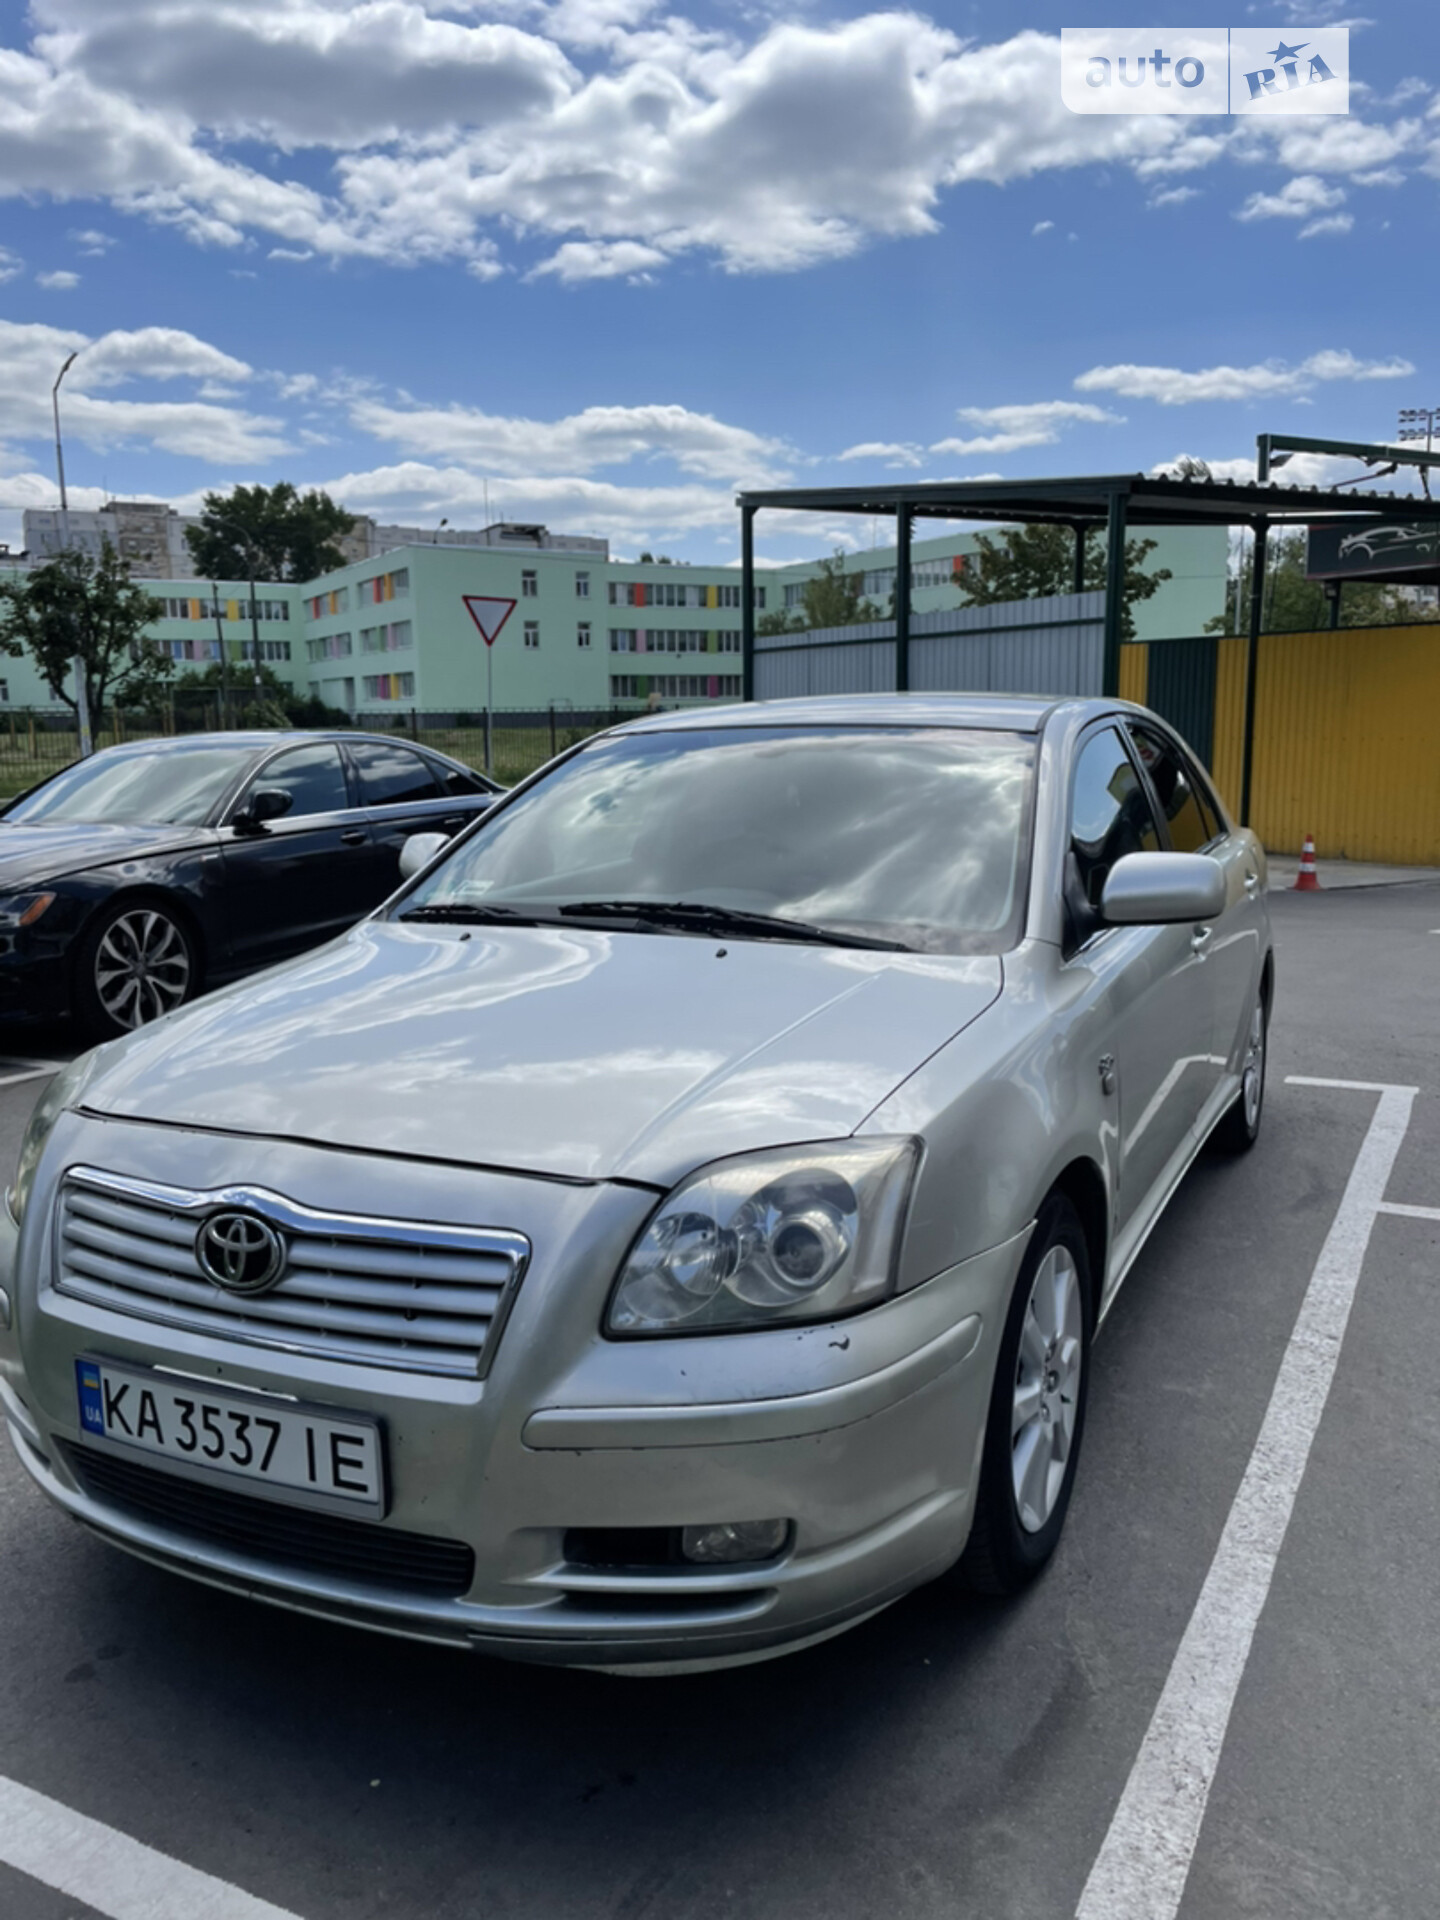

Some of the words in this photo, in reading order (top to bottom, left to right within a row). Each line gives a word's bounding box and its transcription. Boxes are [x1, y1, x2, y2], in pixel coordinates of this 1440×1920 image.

[84, 1405, 103, 1424] UA
[103, 1377, 165, 1445] KA
[173, 1397, 282, 1472] 3537
[305, 1426, 370, 1494] IE
